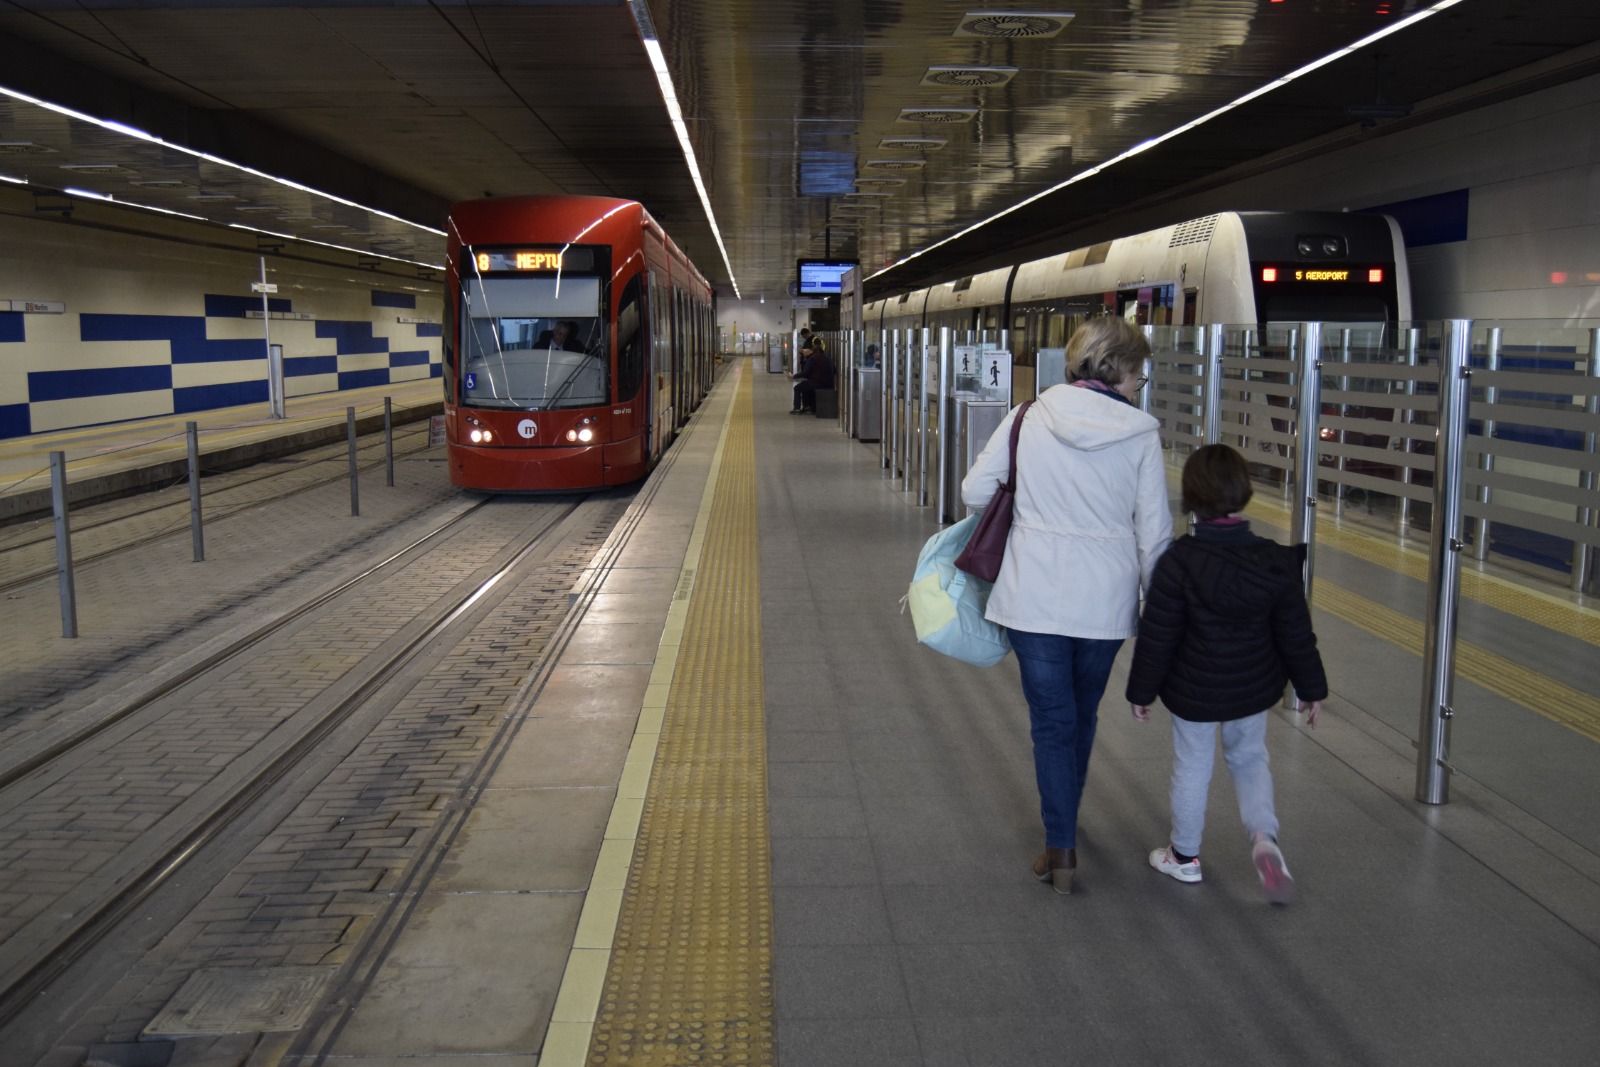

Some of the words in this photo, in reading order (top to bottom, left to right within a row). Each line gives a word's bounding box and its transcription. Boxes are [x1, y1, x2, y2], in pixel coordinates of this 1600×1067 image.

[478, 253, 490, 271] 8
[516, 253, 562, 269] NEPTU
[1296, 271, 1302, 280] 5
[1305, 271, 1348, 280] AEROPORT
